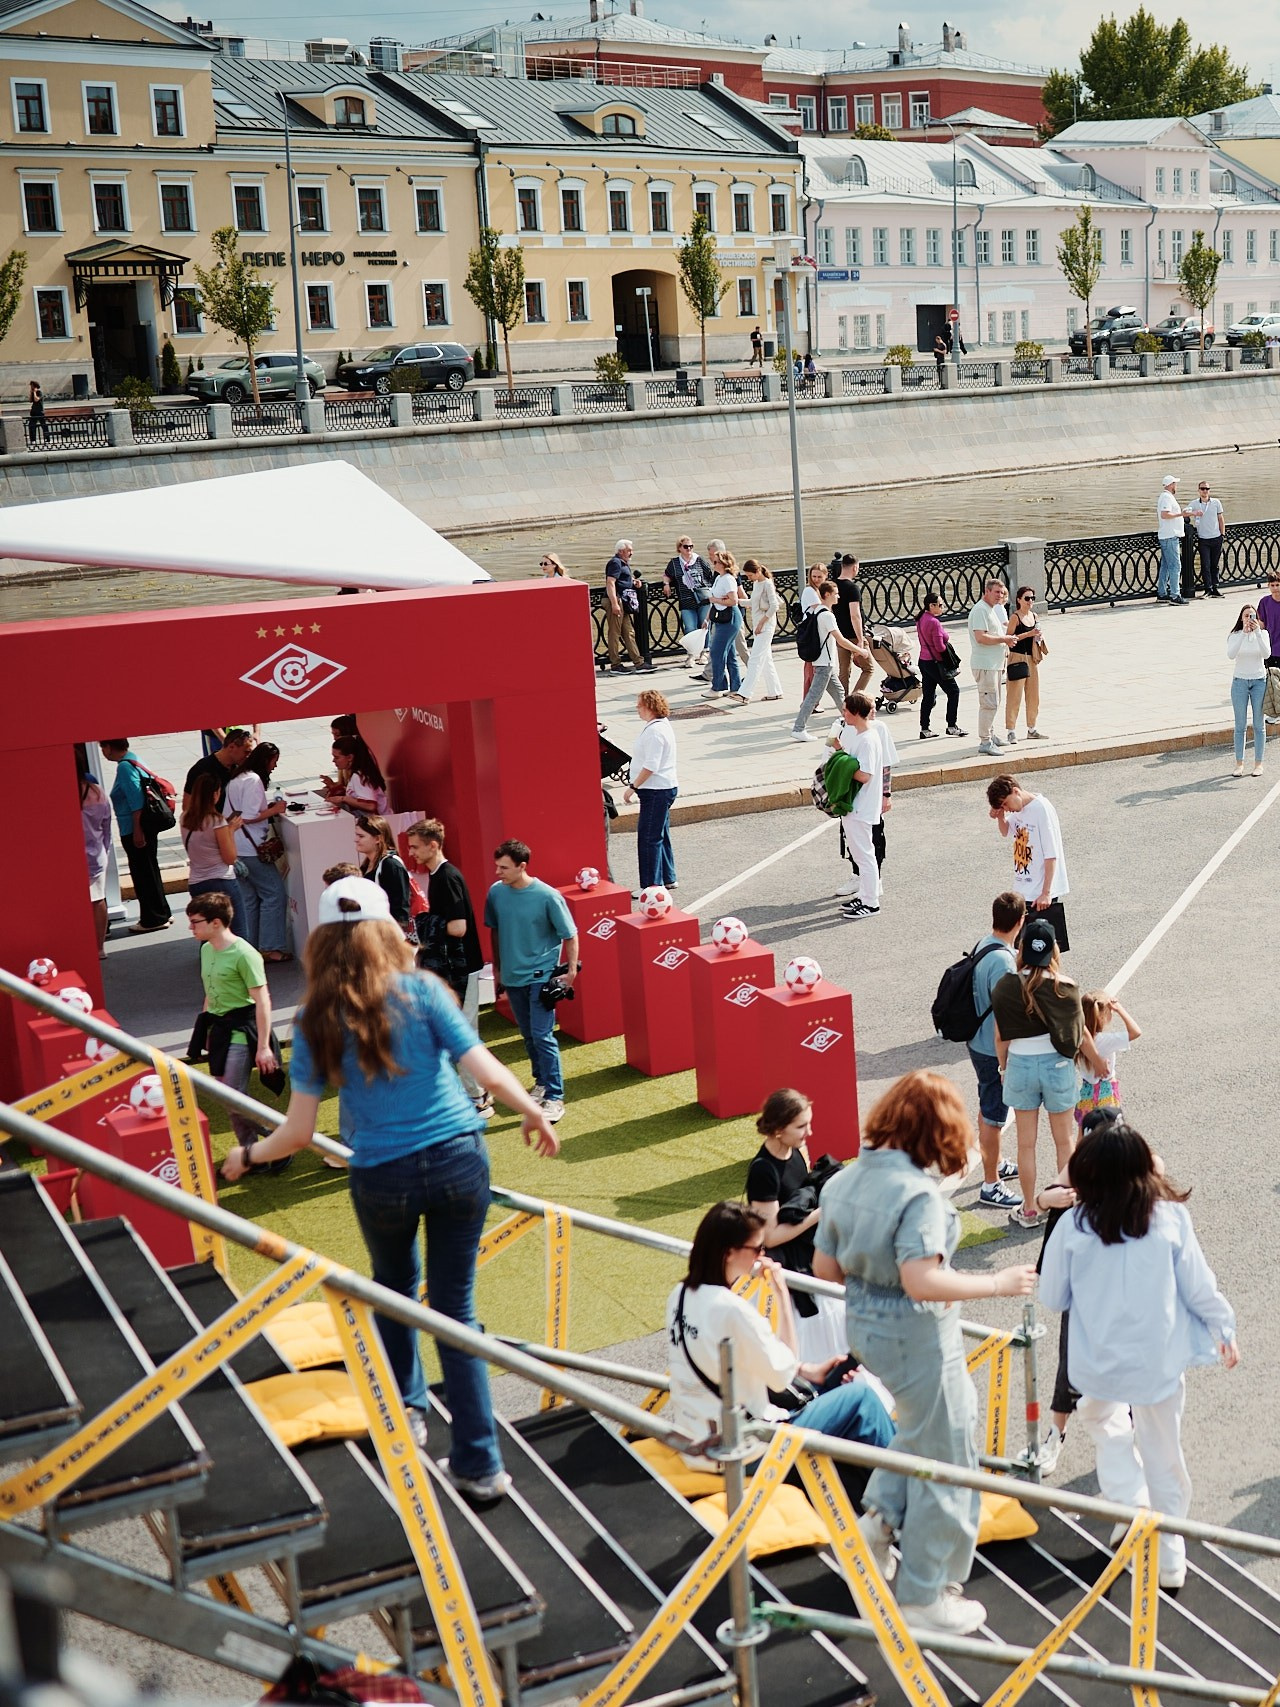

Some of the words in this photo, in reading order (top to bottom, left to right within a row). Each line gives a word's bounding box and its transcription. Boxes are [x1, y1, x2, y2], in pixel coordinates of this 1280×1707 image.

[242, 251, 286, 267] ПЕПЕ
[302, 251, 345, 266] НЕРО
[411, 706, 445, 732] МОСКВА
[183, 1133, 192, 1151] ИЗ
[187, 1154, 203, 1200] УВАЖЕ
[196, 1339, 221, 1361] ИЗ
[340, 1297, 355, 1325] ИЗ
[354, 1330, 394, 1433] УВАЖЕНИЯ
[26, 1472, 53, 1494] ИЗ
[58, 1385, 164, 1470] УВАЖЕНИЯ
[778, 1438, 791, 1460] ИЗ
[401, 1465, 414, 1489] ИЗ
[412, 1493, 449, 1591] УВАЖЕНИЯ
[683, 1584, 700, 1606] ИЗ
[702, 1491, 763, 1579] УВАЖЕНИЯ
[853, 1555, 865, 1575] ИЗ
[865, 1580, 906, 1655] УВАЖЕНИЯ
[453, 1621, 465, 1643] ИЗ
[462, 1647, 484, 1707] УВАЖЕ
[594, 1633, 662, 1707] ВАЖЕНИЯ
[913, 1675, 926, 1694] ИЗ
